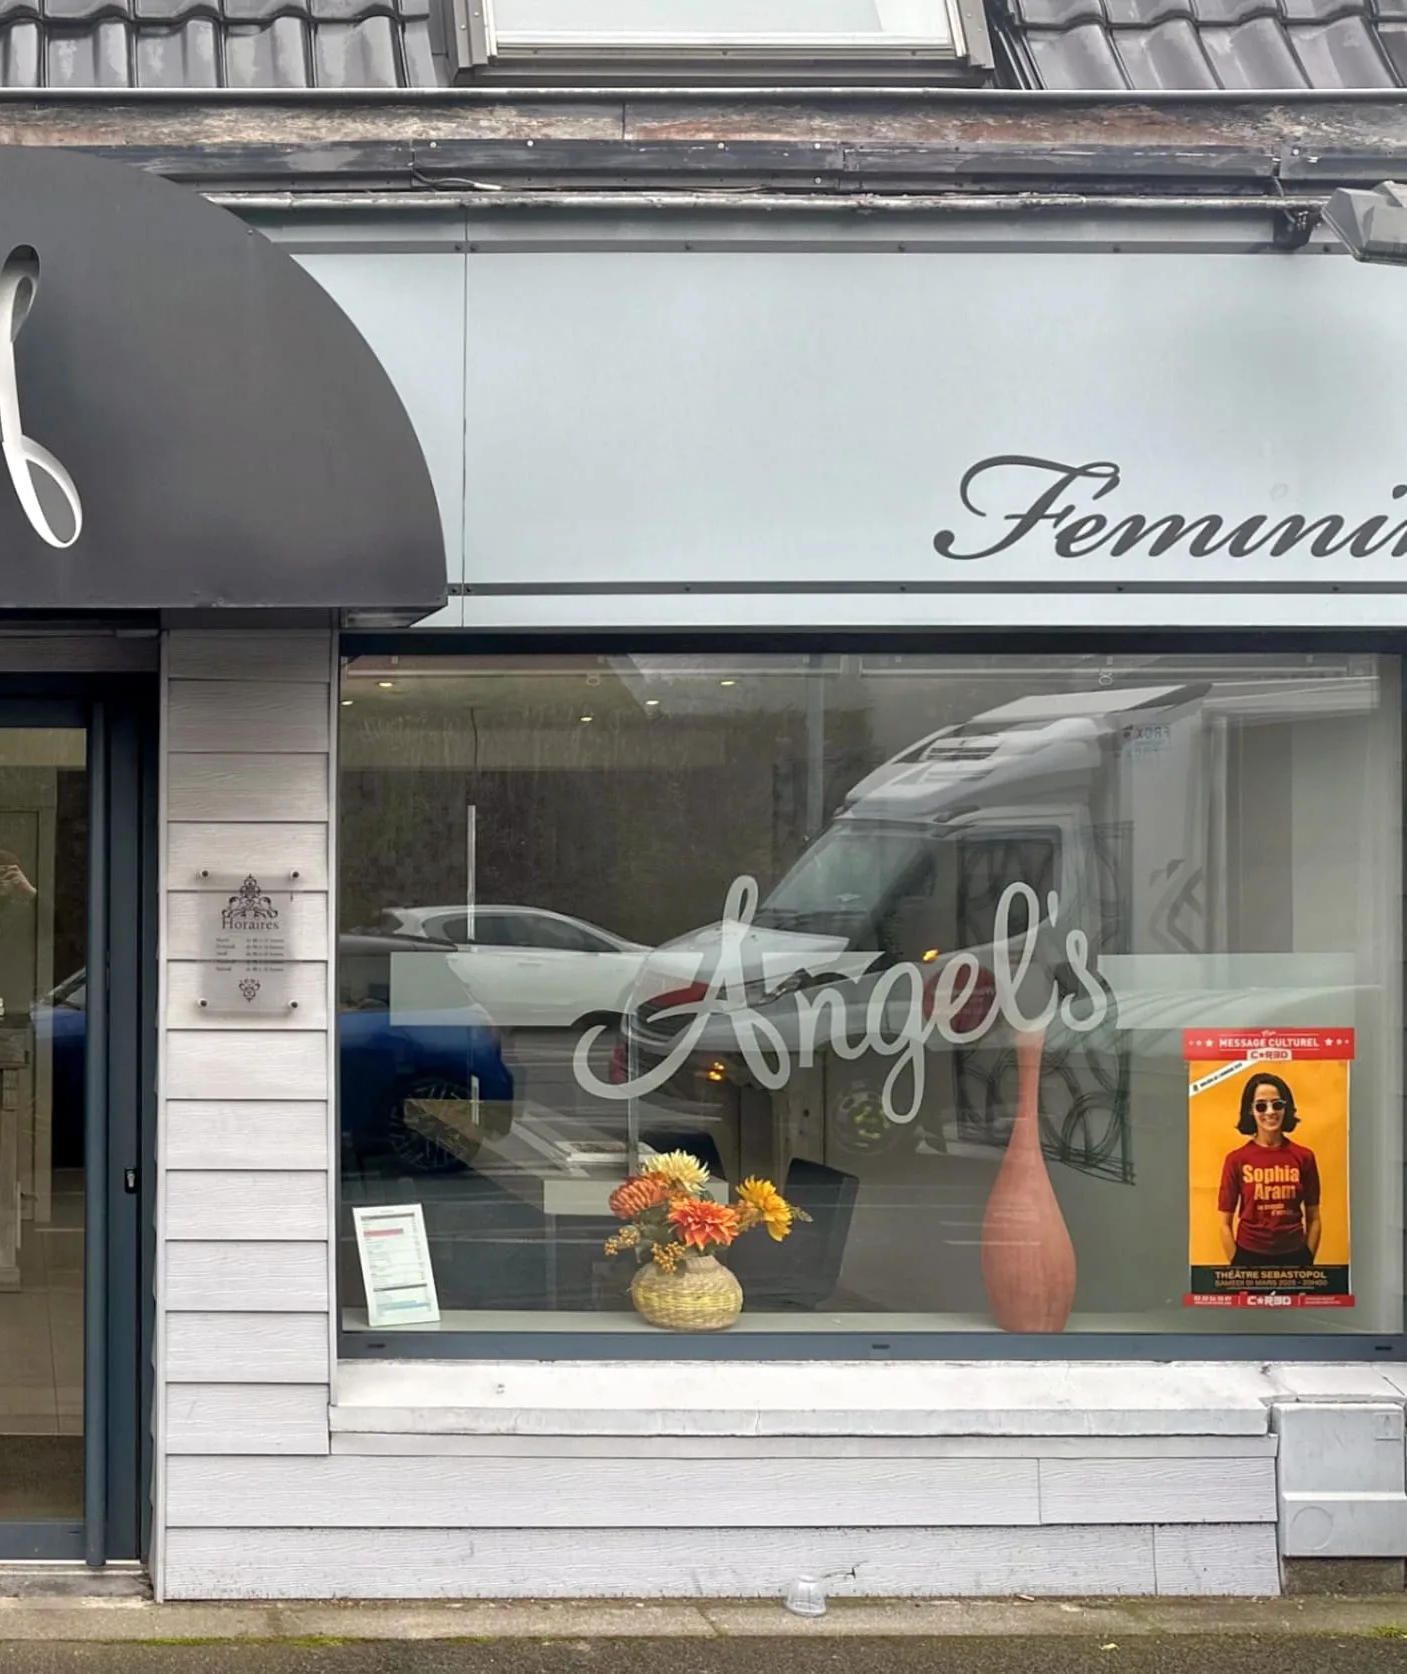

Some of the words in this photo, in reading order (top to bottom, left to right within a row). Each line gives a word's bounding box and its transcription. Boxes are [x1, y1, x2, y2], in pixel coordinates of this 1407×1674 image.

[933, 454, 1407, 560] Femini
[221, 915, 280, 930] Horaires
[572, 874, 1108, 1124] Angel's
[1219, 1037, 1266, 1049] MESSAGE
[1268, 1037, 1320, 1049] CULTUREL
[1242, 1164, 1300, 1184] Sophia
[1254, 1183, 1297, 1200] Aram
[1260, 1270, 1327, 1279] SEBASTOPOL
